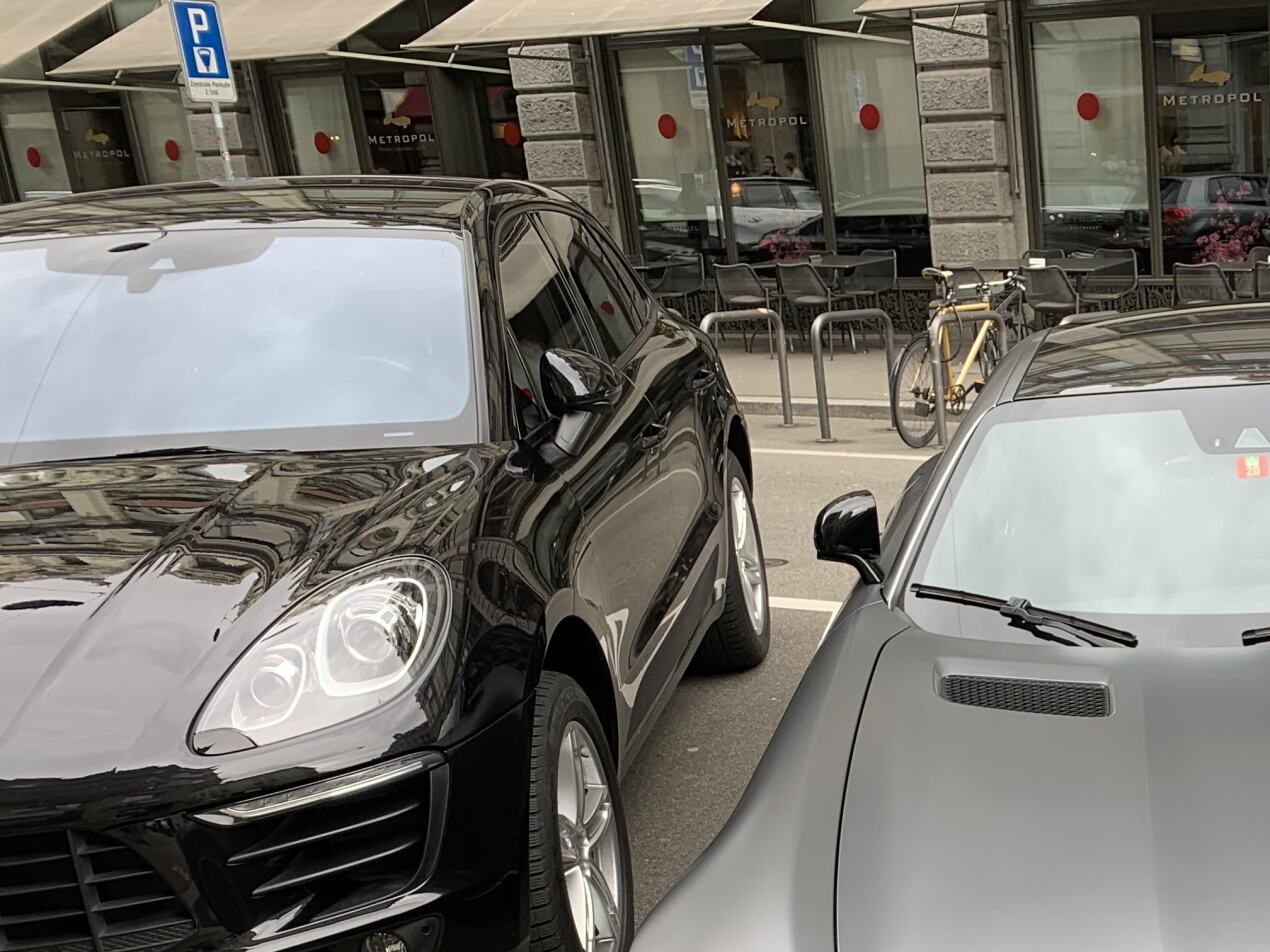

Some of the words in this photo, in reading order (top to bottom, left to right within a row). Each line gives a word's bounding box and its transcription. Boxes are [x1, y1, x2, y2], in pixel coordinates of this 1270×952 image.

[187, 8, 208, 44] P
[1162, 92, 1263, 106] METROPOL
[726, 115, 808, 129] METROPOL
[368, 133, 435, 144] METROPOL
[73, 149, 130, 159] METROPOL
